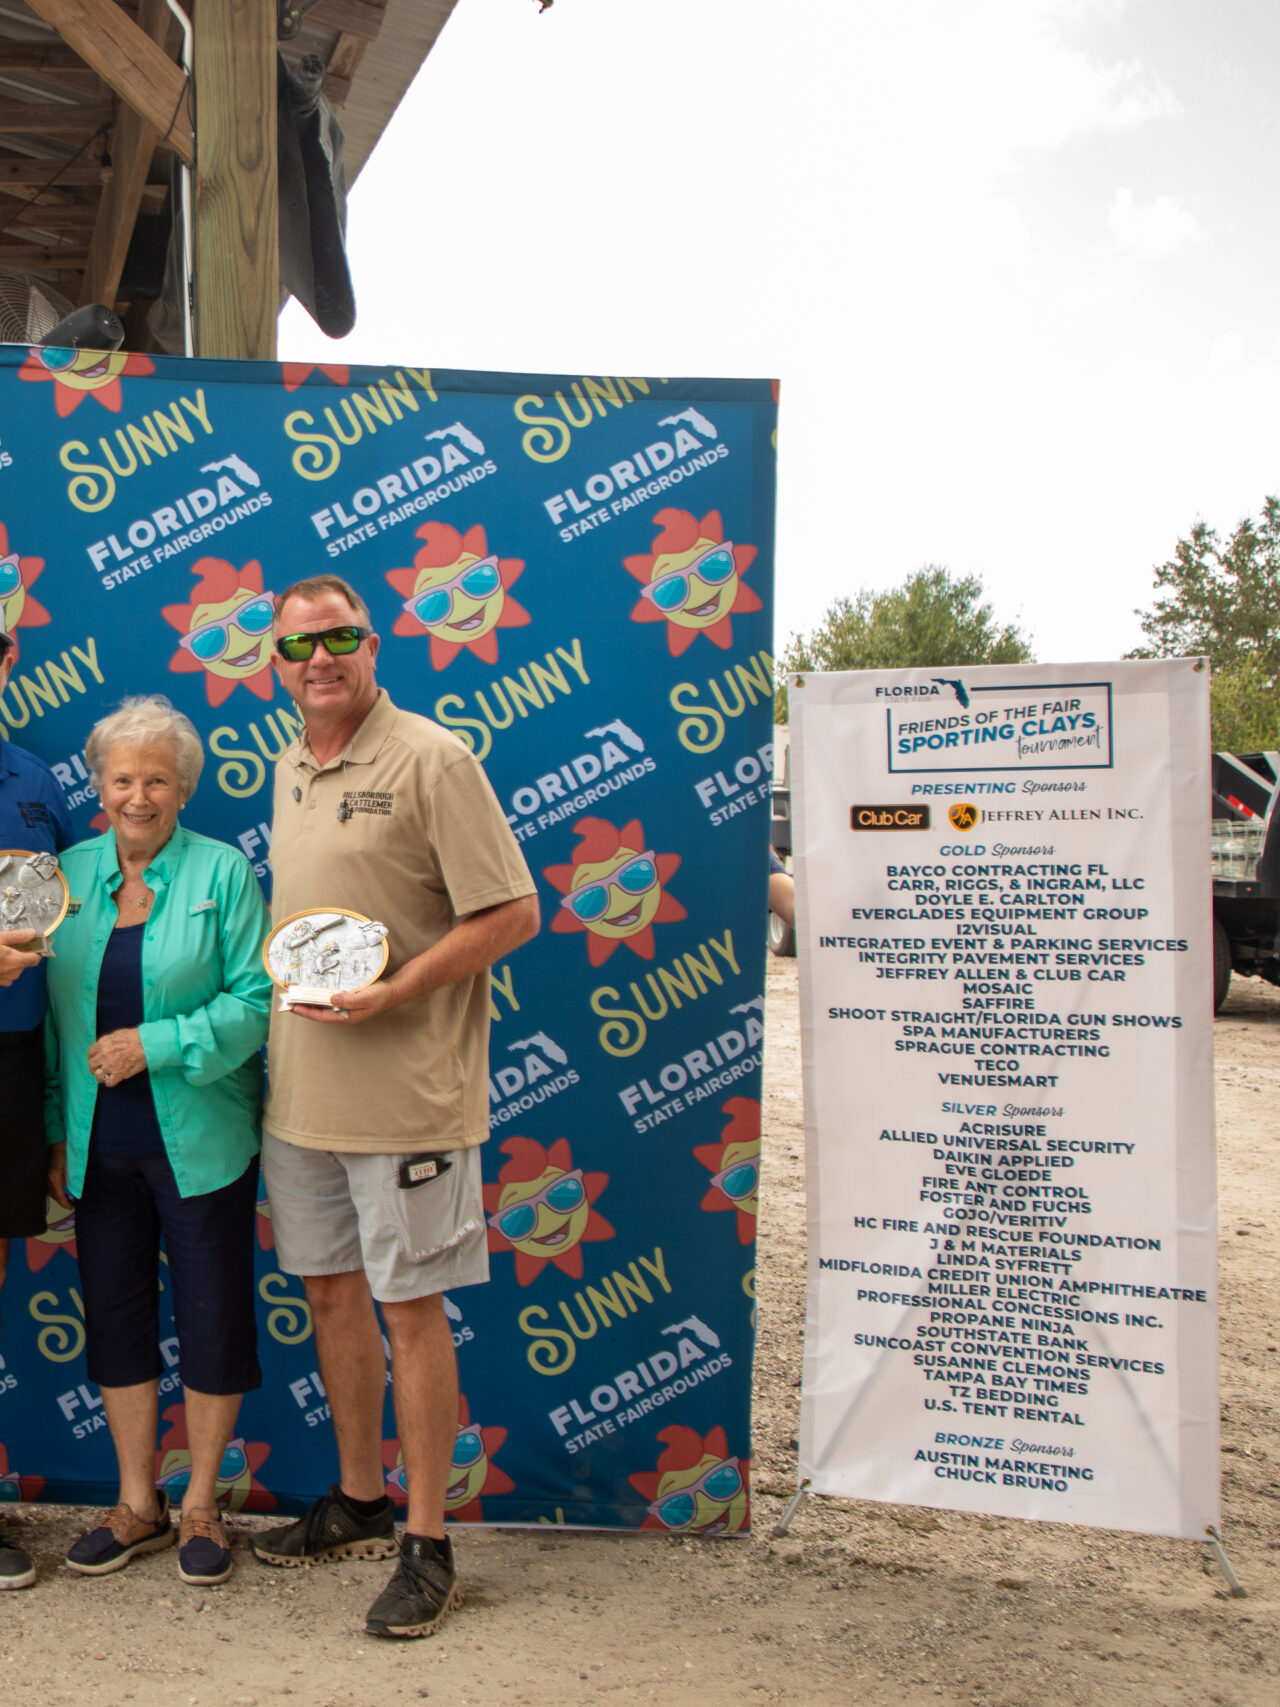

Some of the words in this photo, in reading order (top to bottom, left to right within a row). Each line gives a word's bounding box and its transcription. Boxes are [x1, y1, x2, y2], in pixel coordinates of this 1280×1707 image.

[284, 367, 439, 481] SUNNY
[59, 389, 214, 513] SUNNY
[543, 428, 703, 524] FLORIDA
[310, 443, 472, 538] FLORIDA
[559, 515, 610, 543] STATE
[611, 443, 730, 514] FAIRGROUNDS
[326, 528, 378, 557] STATE
[378, 460, 498, 530] FAIRGROUNDS
[86, 475, 245, 572] FLORIDA
[101, 561, 153, 591] STATE
[154, 492, 272, 561] FAIRGROUNDS
[876, 686, 940, 697] FLORIDA
[898, 715, 969, 735] FRIENDS
[975, 711, 998, 724] OF
[1004, 706, 1037, 720] THE
[1041, 700, 1081, 715] FAIR
[898, 724, 1014, 754] SPORTING
[1022, 712, 1096, 736] CLAYS
[343, 791, 394, 801] HILLSBOROUGH
[350, 799, 393, 809] CATTLEMEN
[538, 757, 657, 832] FAIRGROUNDS
[940, 845, 986, 856] GOLD
[992, 844, 1054, 858] Sponsors
[887, 866, 946, 877] BAYCO
[952, 864, 1082, 876] CONTRACTING
[1088, 864, 1109, 876] FL
[888, 880, 939, 892] CARR,
[946, 879, 1003, 892] RIGGS,
[1009, 879, 1020, 890] &
[1028, 878, 1106, 892] INGRAM,
[1112, 878, 1144, 890] LLC
[852, 908, 965, 920] EVERGLADES
[971, 908, 1078, 922] EQUIPMENT
[1083, 908, 1149, 920] GROUP
[957, 924, 1037, 935] I2VISUAL
[820, 936, 925, 949] INTEGRATED
[931, 938, 987, 949] EVENT
[993, 939, 1004, 949] &
[1011, 939, 1092, 950] PARKING
[1098, 939, 1188, 952] SERVICES
[589, 929, 742, 1057] SUNNY
[964, 983, 1033, 994] MOSAIC
[828, 1008, 886, 1020] SHOOT
[891, 1010, 1062, 1025] STRAIGHT/FLORIDA
[1067, 1014, 1106, 1026] GUN
[1112, 1014, 1182, 1028] SHOWS
[903, 1025, 936, 1037] SPA
[942, 1027, 1100, 1040] MANUFACTURERS
[619, 1016, 765, 1116] FLORIDA
[938, 1073, 1059, 1087] VENUESMART
[634, 1100, 684, 1134] STATE
[960, 1122, 1046, 1136] ACRISURE
[879, 1130, 938, 1144] ALLIED
[943, 1134, 1042, 1151] UNIVERSAL
[1047, 1140, 1135, 1154] SECURITY
[933, 1148, 992, 1165] DAIKIN
[998, 1156, 1074, 1168] APPLIED
[944, 1208, 1067, 1227] GOJO/VERITIV
[820, 1258, 922, 1278] MIDFLORIDA
[927, 1268, 990, 1282] CREDIT
[996, 1274, 1052, 1289] UNION
[1059, 1280, 1206, 1302] AMPHITHEATRE
[519, 1247, 673, 1376] SUNNY
[930, 1312, 1014, 1328] PROPANE
[1022, 1318, 1074, 1335] NINJA
[854, 1334, 945, 1352] SUNCOAST
[951, 1342, 1069, 1363] CONVENTION
[1076, 1354, 1164, 1374] SERVICES
[549, 1338, 701, 1436] FLORIDA
[923, 1369, 985, 1384] TAMPA
[992, 1374, 1028, 1388] BAY
[1033, 1378, 1088, 1395] TIMES
[565, 1422, 617, 1455] STATE
[617, 1352, 733, 1428] FAIRGROUNDS
[924, 1398, 957, 1412] U.S.
[962, 1402, 1008, 1417] TENT
[1014, 1407, 1085, 1426] RENTAL
[914, 1450, 978, 1467] AUSTIN
[985, 1457, 1093, 1480] MARKETING
[934, 1466, 997, 1484] CHUCK
[1002, 1474, 1068, 1492] BRUNO
